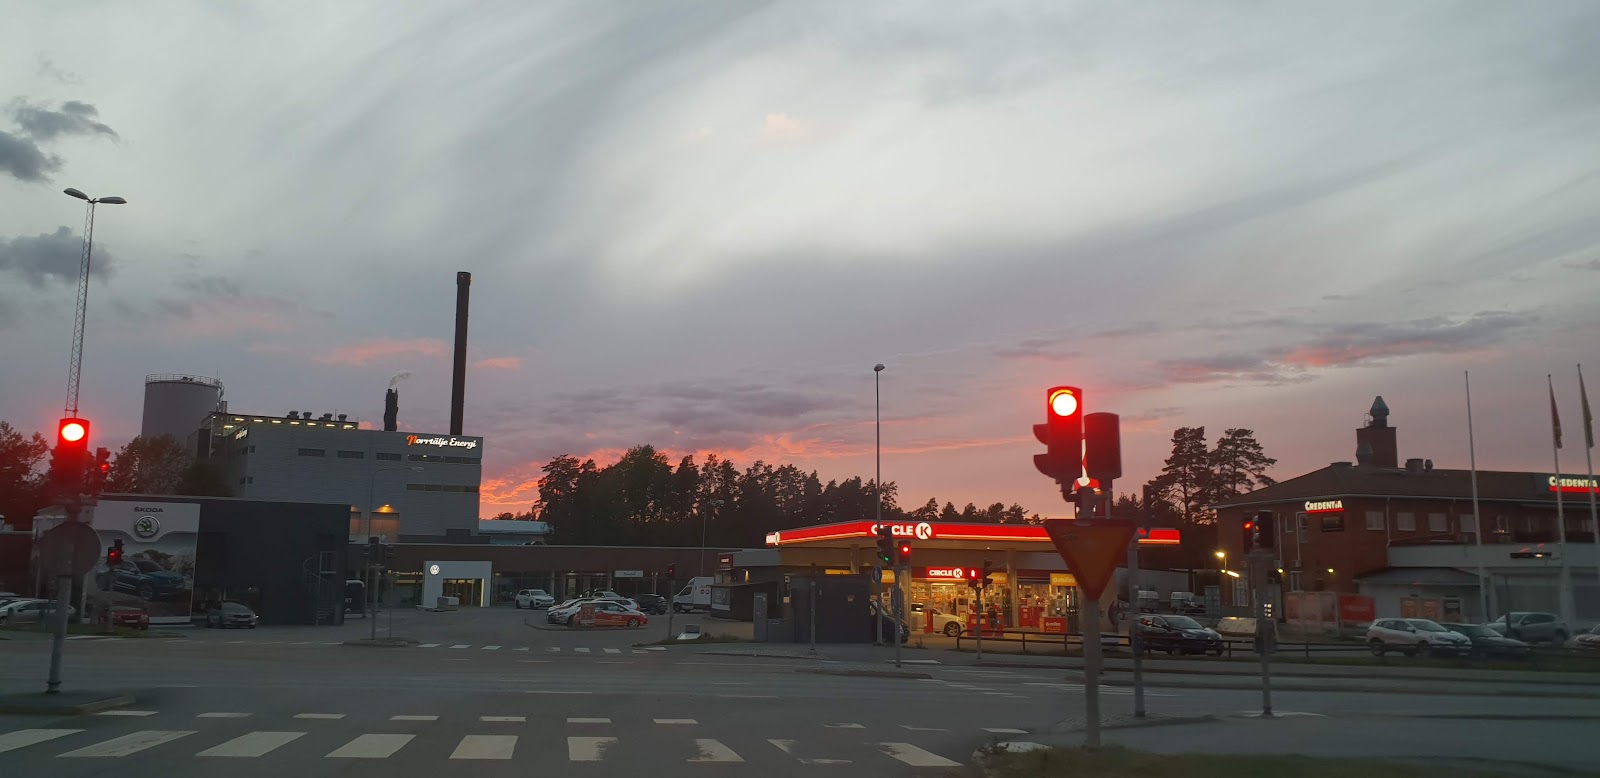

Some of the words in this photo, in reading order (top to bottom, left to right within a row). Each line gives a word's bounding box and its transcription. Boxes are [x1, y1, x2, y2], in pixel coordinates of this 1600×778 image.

[406, 435, 448, 447] Norrtälje
[449, 438, 477, 449] Energi
[871, 523, 914, 536] CCLE
